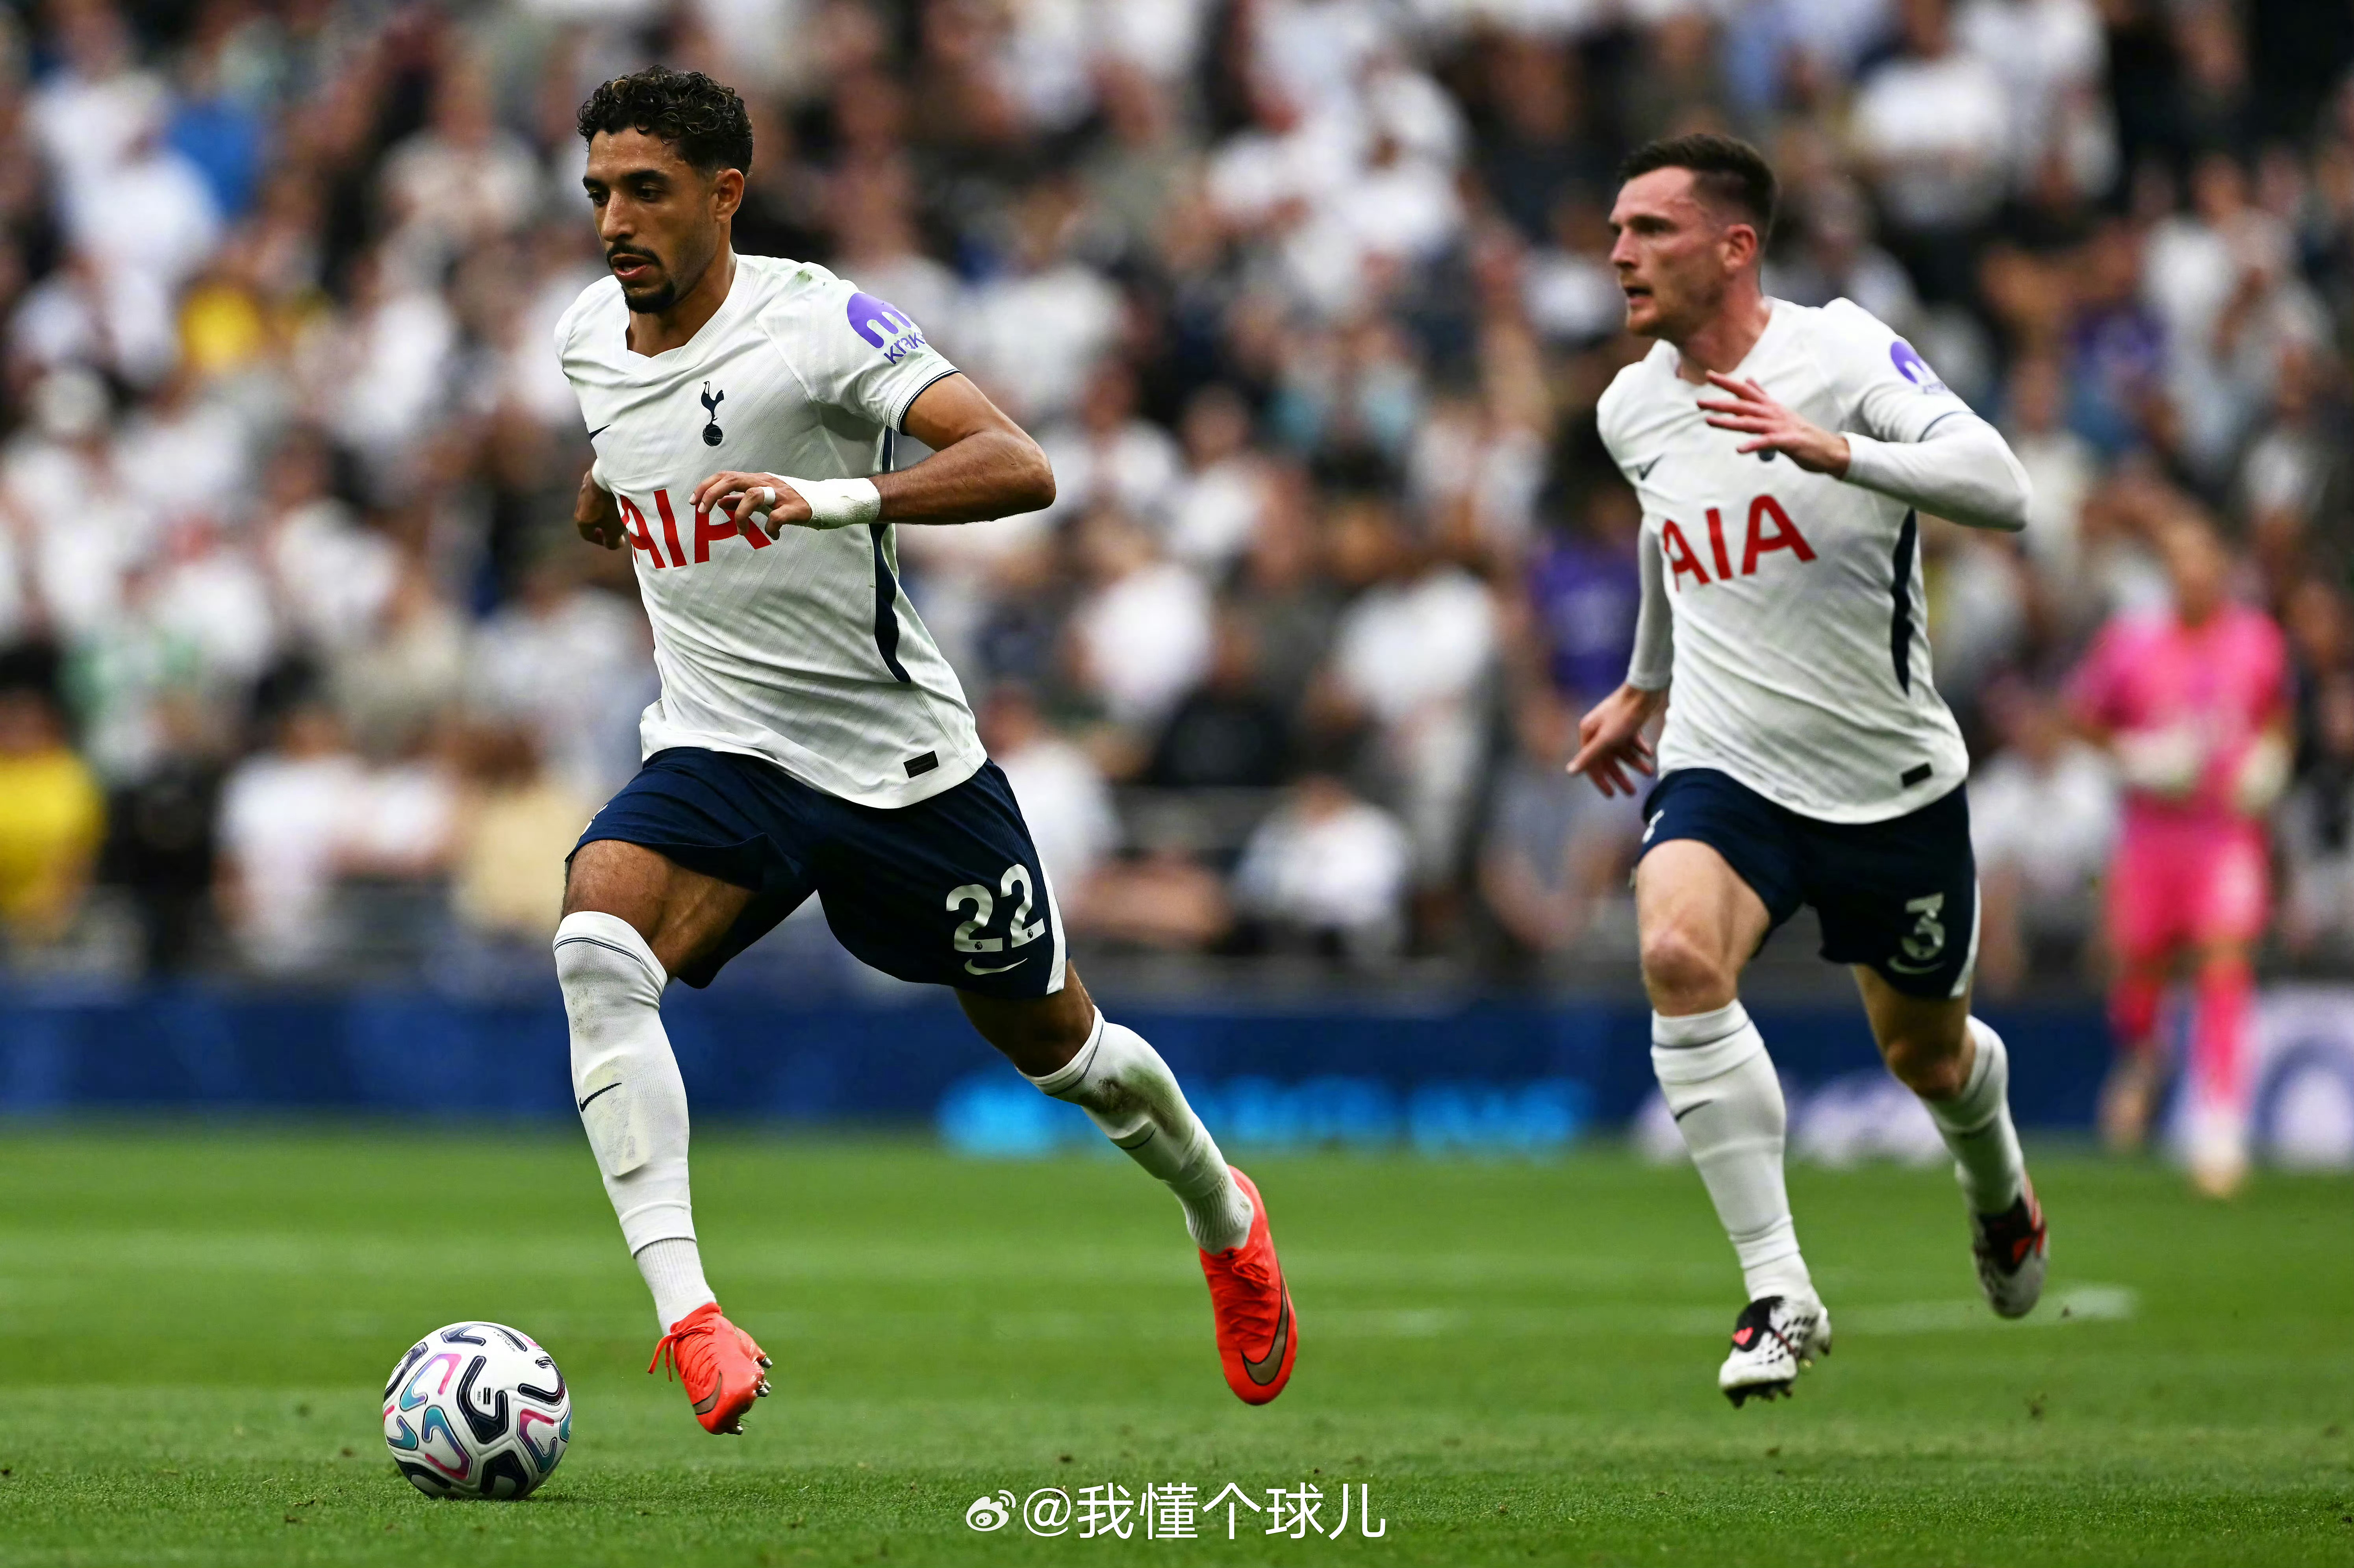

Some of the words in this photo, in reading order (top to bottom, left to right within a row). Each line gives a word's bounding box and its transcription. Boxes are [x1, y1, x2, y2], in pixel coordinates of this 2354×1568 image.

[620, 489, 772, 569] AIA
[1663, 495, 1816, 591] AIA
[946, 864, 1045, 952] 22
[1901, 892, 1945, 960] 3
